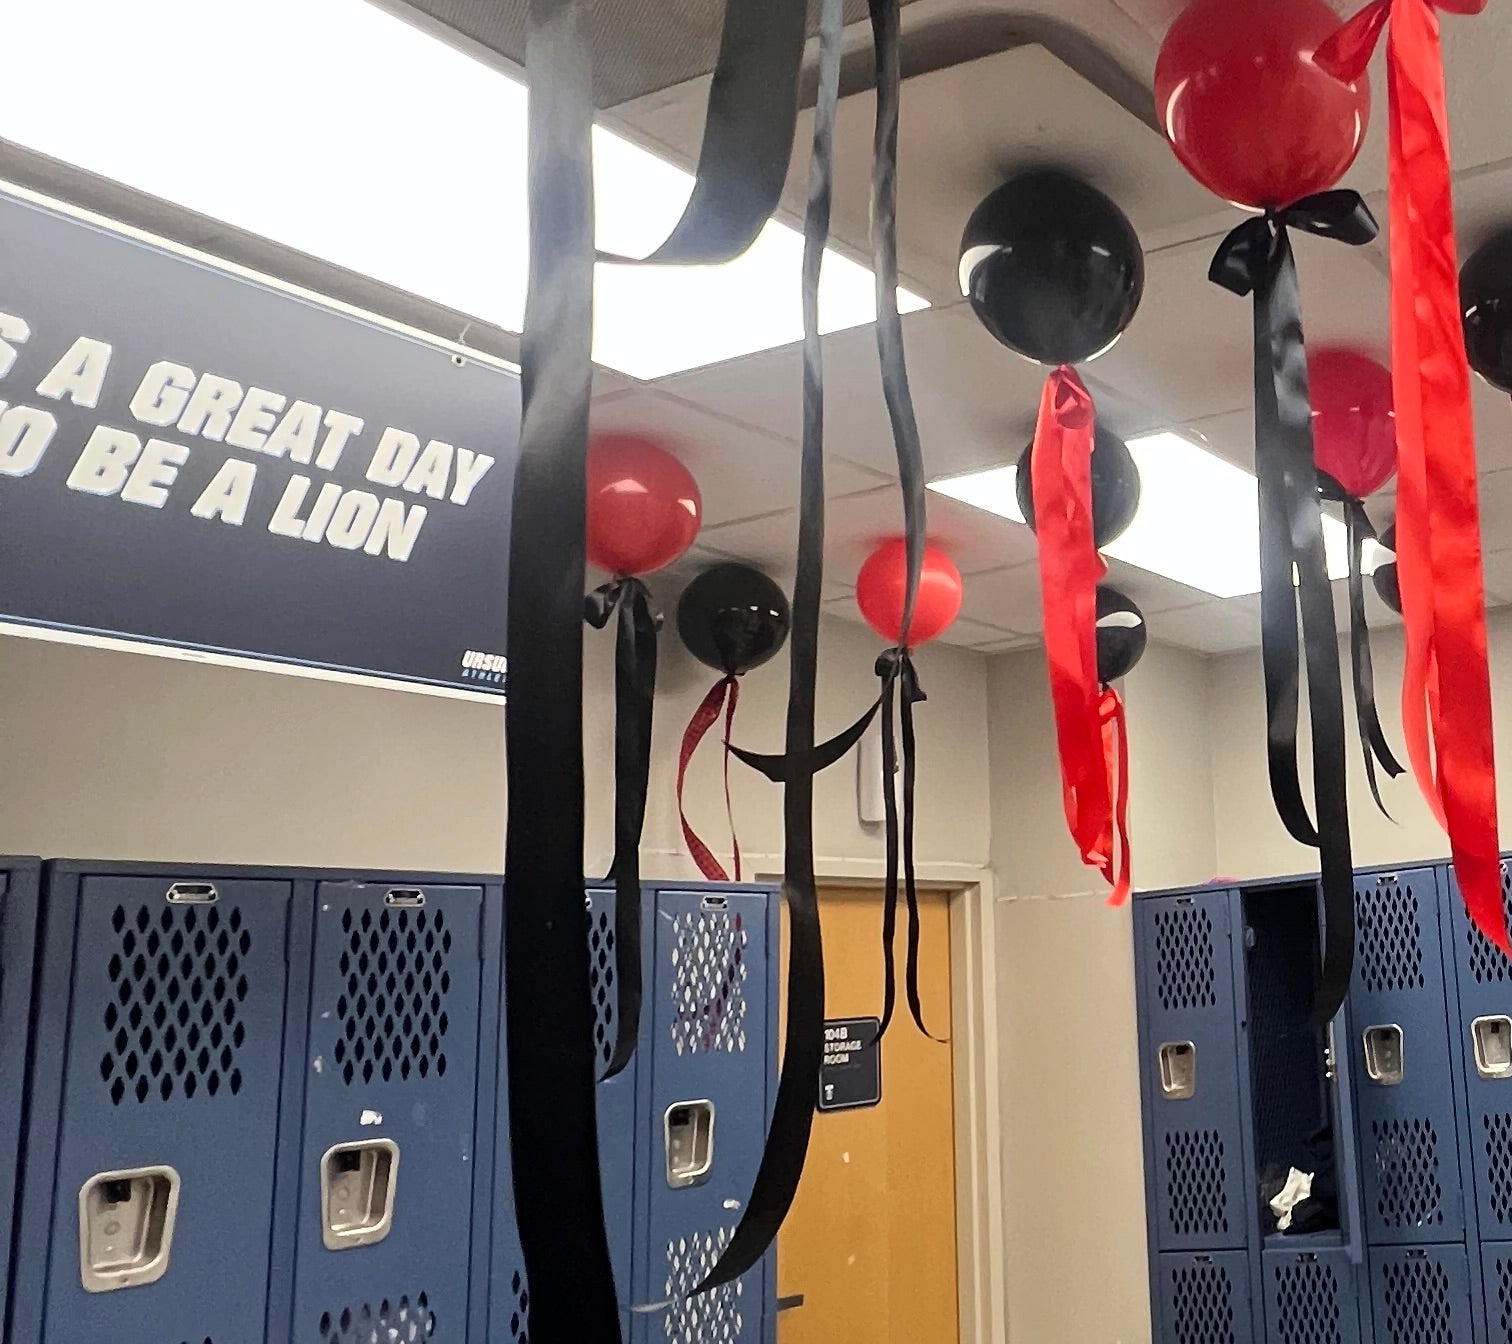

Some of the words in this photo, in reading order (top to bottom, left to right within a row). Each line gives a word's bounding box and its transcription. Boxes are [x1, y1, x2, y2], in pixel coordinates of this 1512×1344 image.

[36, 337, 112, 409] A
[129, 361, 364, 471] GREAT
[366, 427, 495, 506] DAY
[66, 425, 190, 509] BE
[190, 458, 258, 526] A
[268, 475, 428, 562] LION
[824, 1040, 862, 1053] STORAGE
